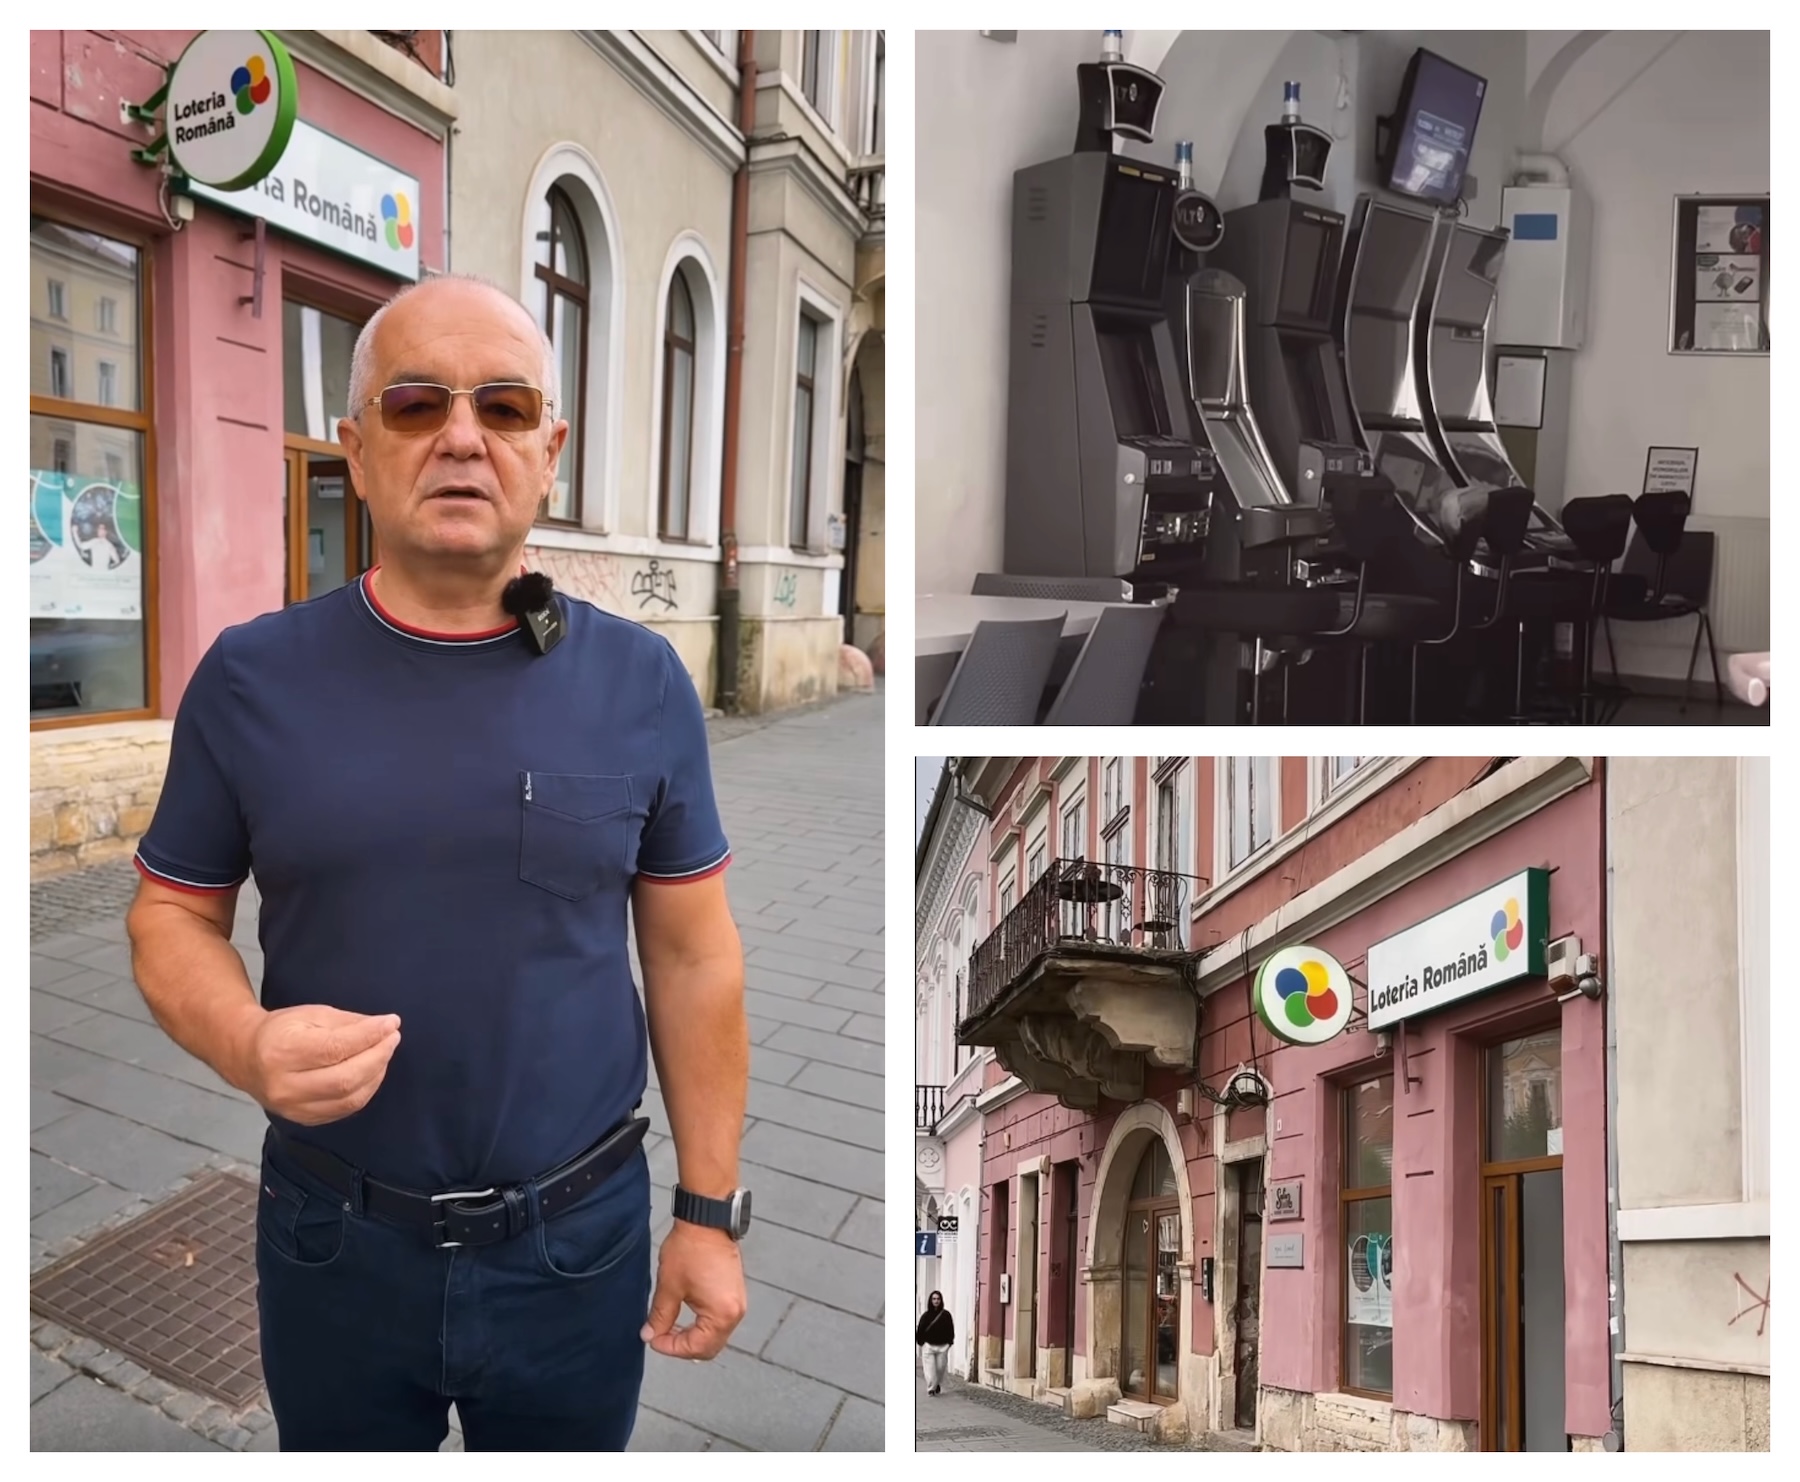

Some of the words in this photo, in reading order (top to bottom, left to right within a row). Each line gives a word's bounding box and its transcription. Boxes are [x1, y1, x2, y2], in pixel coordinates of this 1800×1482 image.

[174, 91, 226, 121] Loteria
[176, 111, 235, 145] Română
[293, 178, 377, 242] Română
[1371, 974, 1418, 1013] Loteria
[1423, 943, 1488, 993] Română
